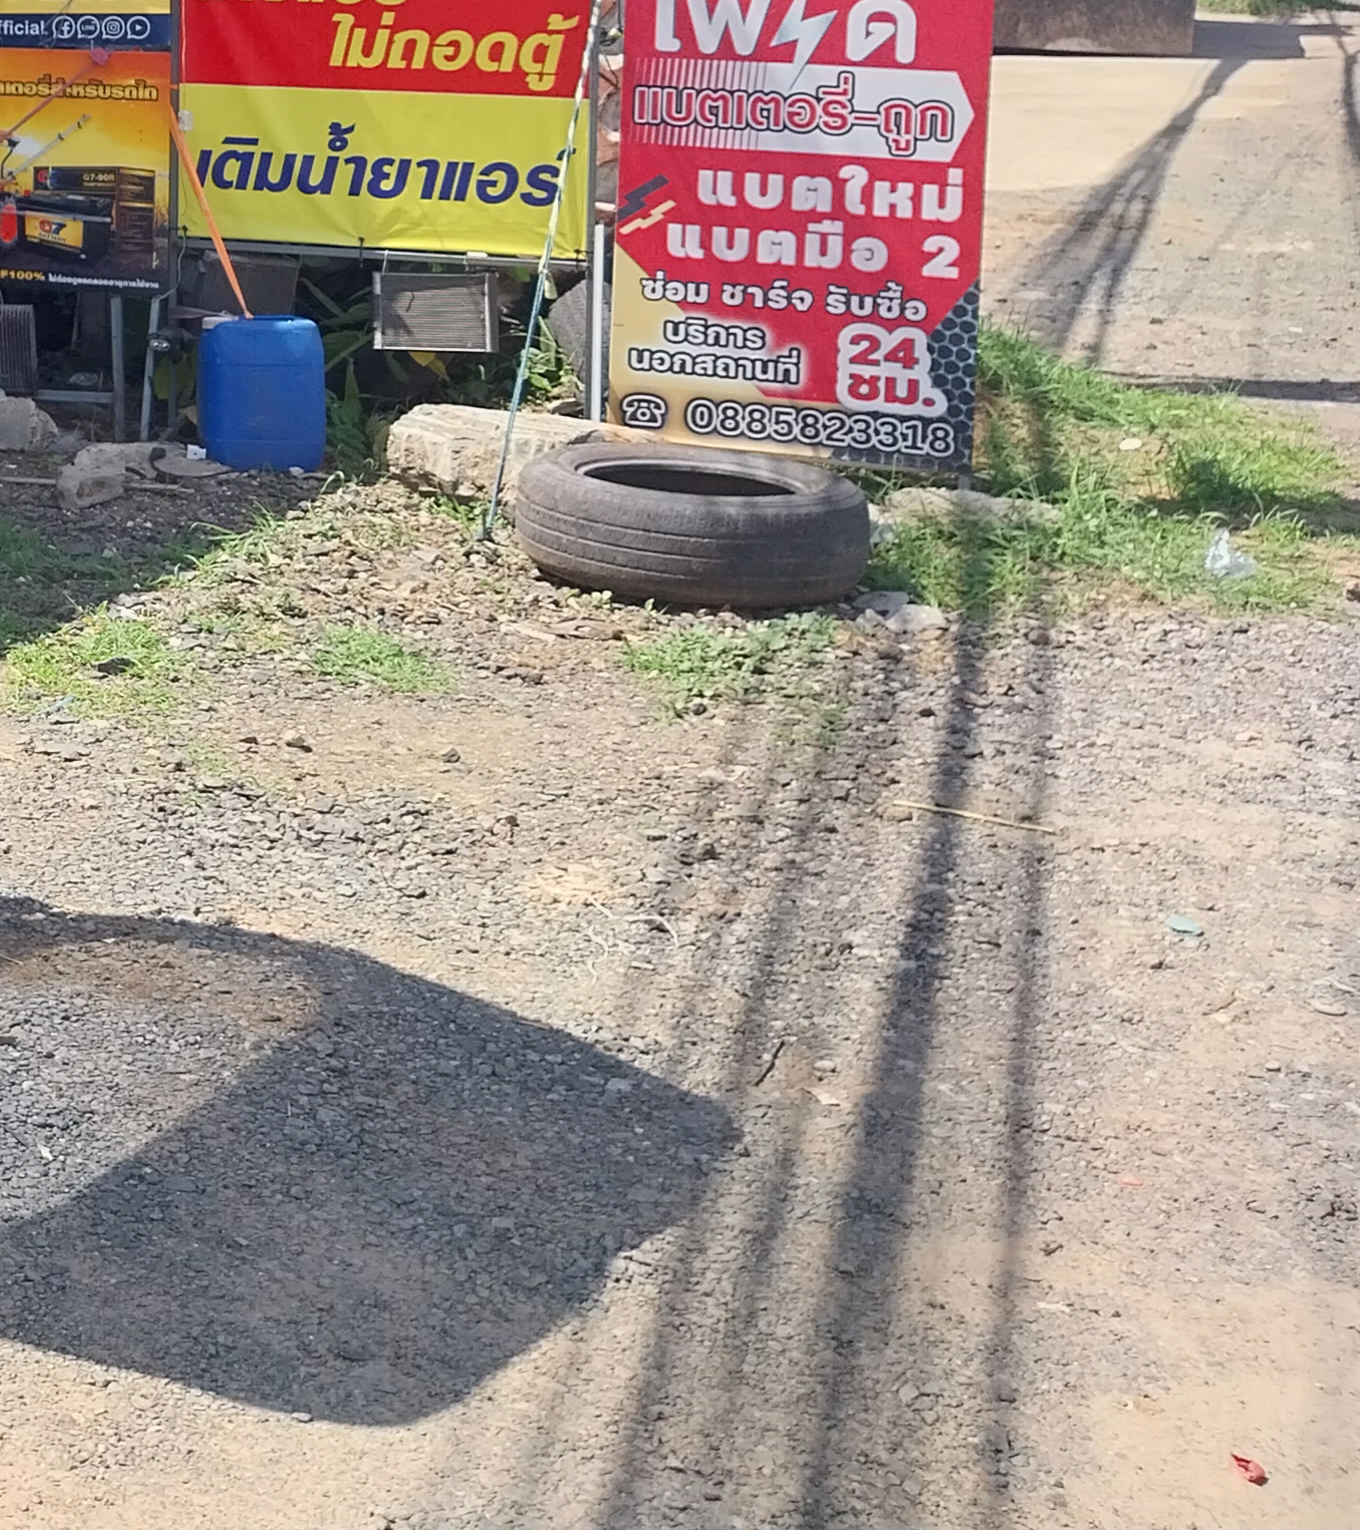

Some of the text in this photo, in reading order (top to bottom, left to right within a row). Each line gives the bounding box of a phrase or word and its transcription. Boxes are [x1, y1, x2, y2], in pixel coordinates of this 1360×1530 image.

[329, 11, 579, 91] ไม่ถอดตู้
[632, 71, 955, 157] แบตเตอรี่-ถูก
[195, 121, 577, 207] เติมน้ำยาแอร์
[697, 164, 964, 223] แบตใหม่
[666, 218, 961, 280] แบตมือ 2
[640, 270, 928, 322] ซ่อม ชาร์จ รับซื้อ
[663, 317, 765, 351] บริการ
[848, 333, 920, 370] 24
[628, 343, 801, 385] นอกสถานที่
[847, 373, 937, 409] ชม.
[685, 398, 955, 457] 0885823318
